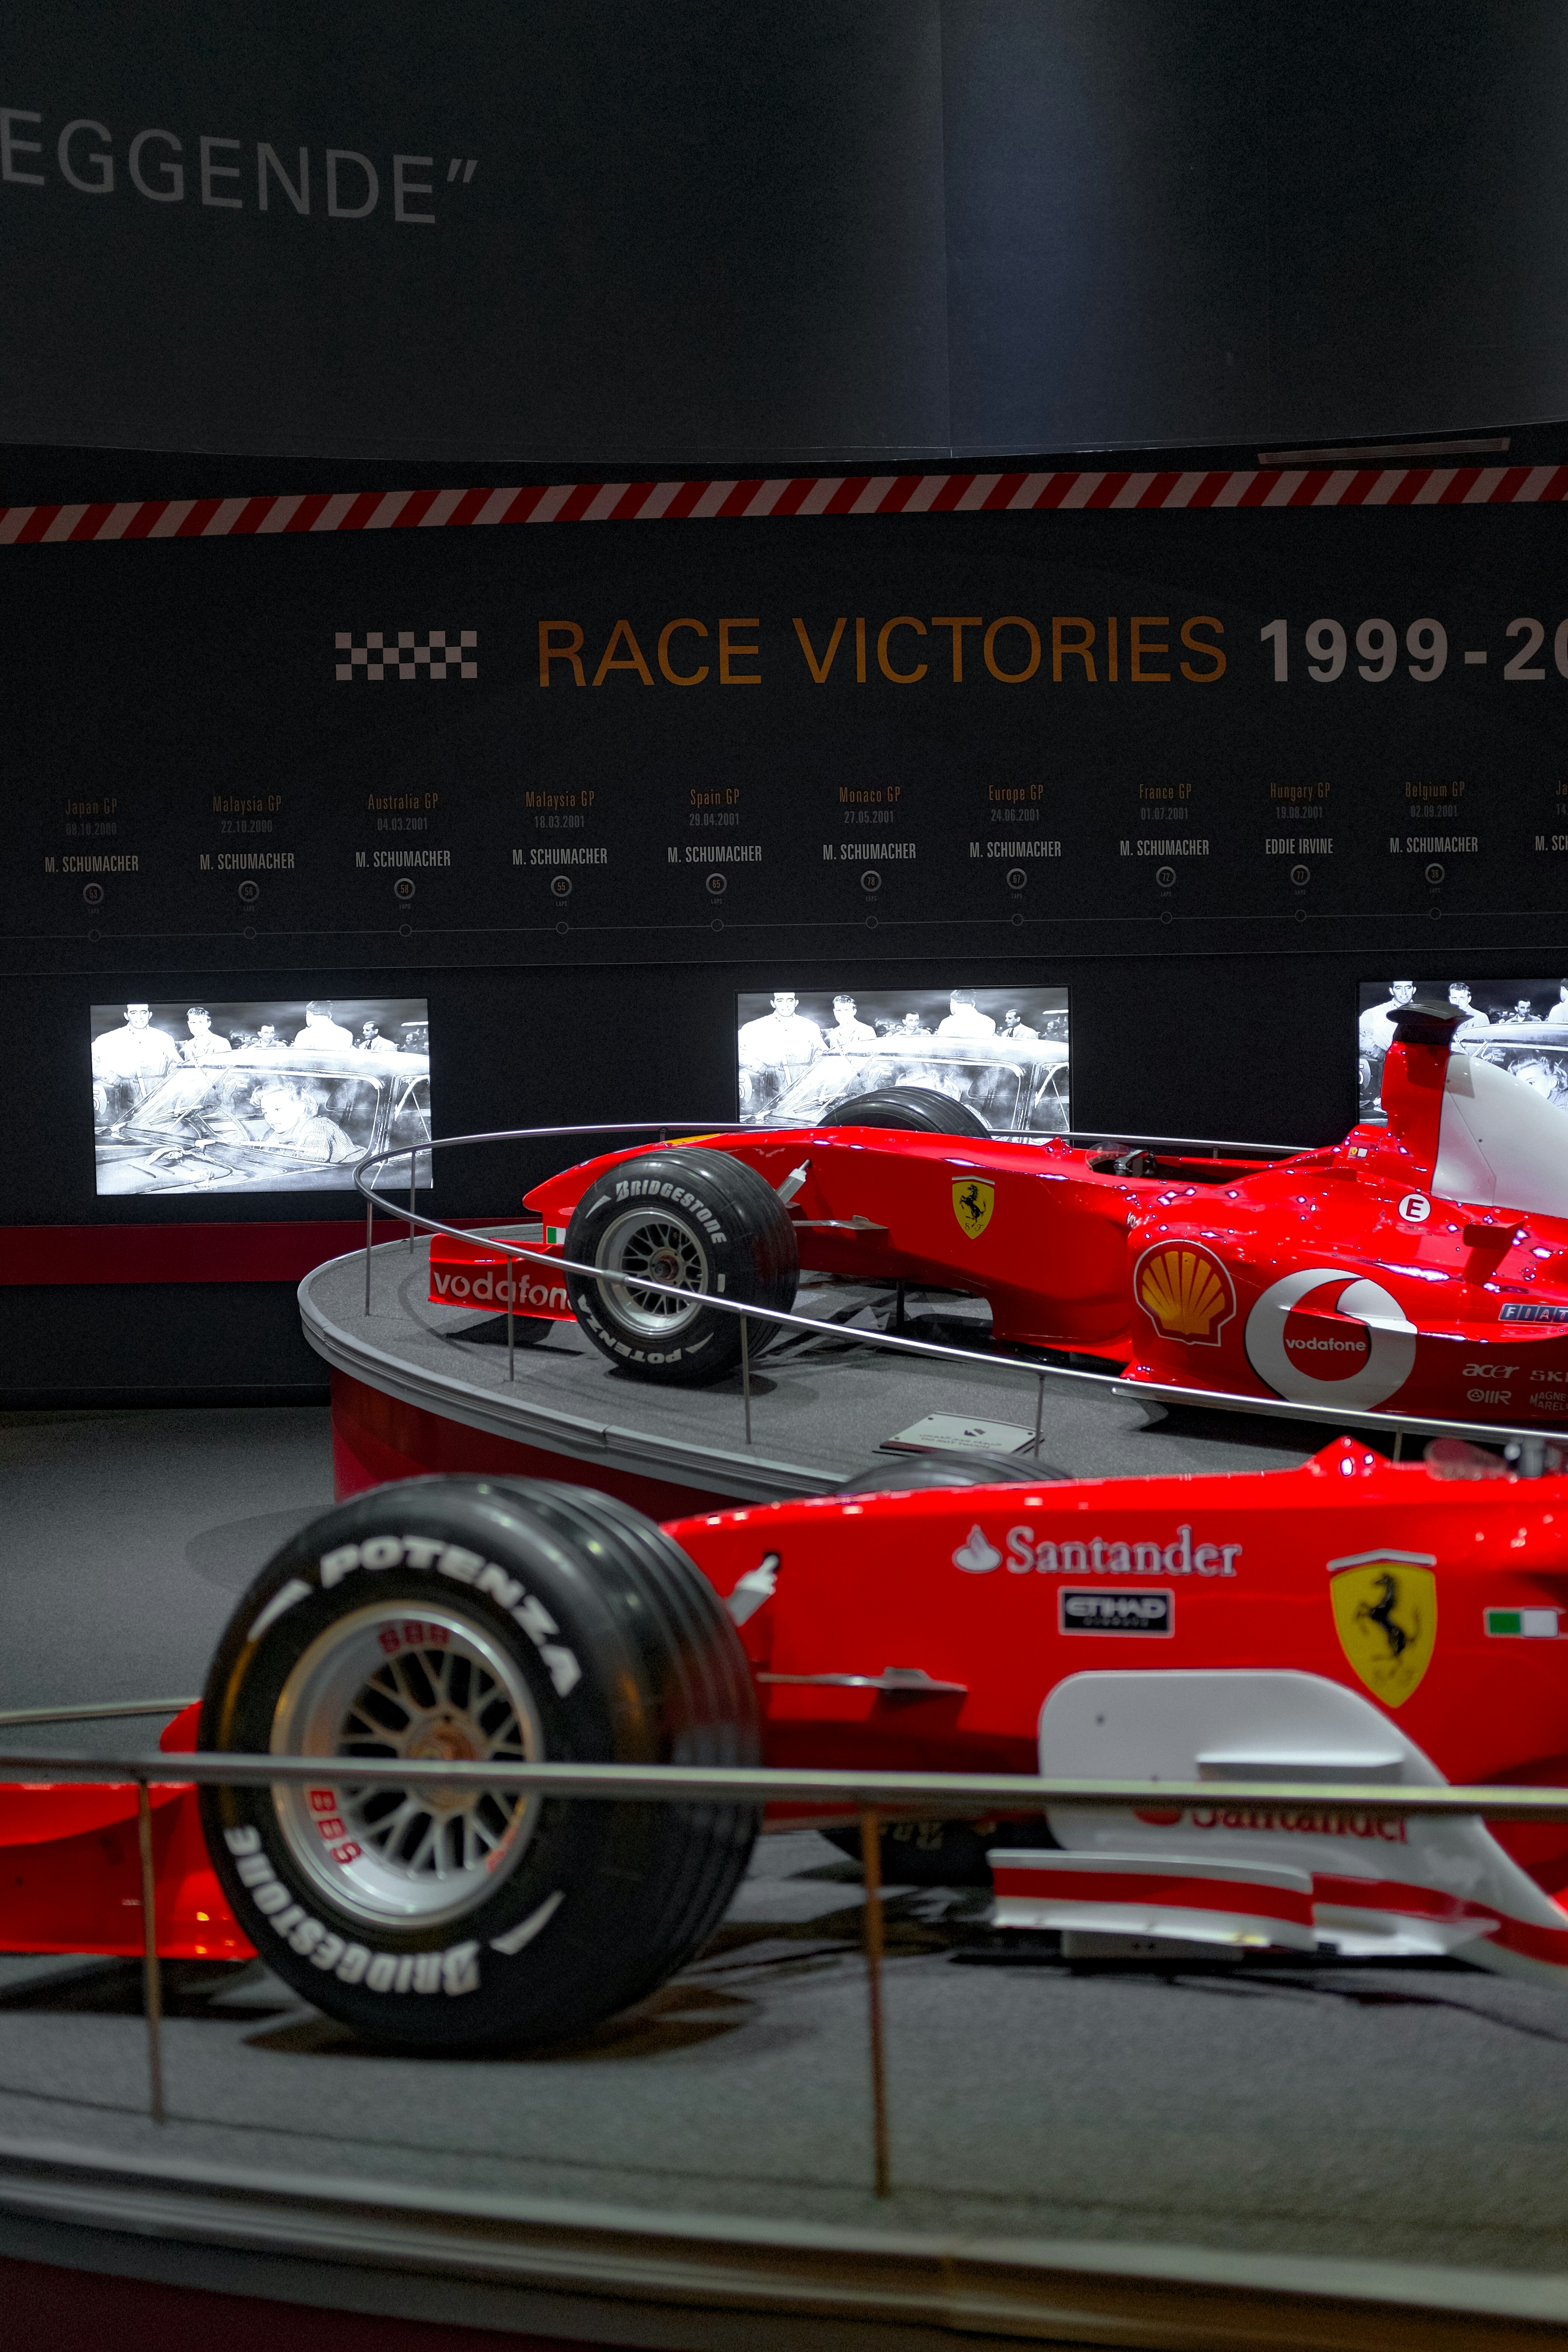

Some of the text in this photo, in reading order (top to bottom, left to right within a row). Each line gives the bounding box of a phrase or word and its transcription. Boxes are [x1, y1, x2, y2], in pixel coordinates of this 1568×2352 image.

[539, 618, 762, 687] RACE
[793, 616, 1227, 684] VICTORIES
[691, 788, 740, 808] Spain GP
[839, 786, 900, 802] Monaco GP
[989, 784, 1043, 804] Europe GP
[1139, 783, 1191, 799] France GP
[1271, 782, 1330, 802] Hungary GP
[1405, 781, 1465, 801] Belgium GP
[66, 798, 117, 818] Japan GP
[213, 795, 281, 815] Malaysia GP
[368, 793, 438, 810] Australia GP
[526, 790, 594, 810] Malaysia GP
[844, 810, 893, 823] 27.05.2001
[991, 808, 1039, 821] 24.06.2001
[1141, 807, 1188, 820] 01.07.2001
[1410, 805, 1457, 817] 02.09.2001
[221, 820, 273, 833] 22.10.2000
[377, 817, 427, 831] 04.03.2001
[535, 815, 584, 828] 18.03.2001
[689, 813, 739, 826] 29.04.2001
[823, 843, 916, 860] M. SCHUMACHER
[970, 841, 1061, 858] M. SCHUMACHER
[1120, 840, 1209, 856] M. SCHUMACHER
[1266, 838, 1333, 854] EDDIE IRVINE
[1390, 837, 1478, 853] M. SCHUMACHER
[1535, 836, 1548, 851] M.
[200, 853, 294, 870] M. SCHUMACHER
[356, 850, 450, 867] M. SCHUMACHER
[513, 848, 607, 865] M. SCHUMACHER
[668, 846, 762, 863] M. SCHUMACHER
[45, 855, 138, 872] M. SCHUMACHER
[867, 876, 876, 886] 78
[1012, 874, 1021, 884] 67
[1161, 873, 1171, 882] 72
[1296, 870, 1305, 880] 77
[1431, 868, 1439, 879] 36
[400, 884, 409, 894] 58
[557, 881, 566, 891] 55
[712, 879, 721, 889] 65
[616, 1180, 727, 1244] BRIDGESTONE
[1406, 1198, 1424, 1218] E
[434, 1271, 573, 1310] vodafon
[577, 1294, 682, 1364] POTENZA
[1285, 1337, 1366, 1351] vodafone
[1462, 1363, 1520, 1378] acer
[1530, 1370, 1568, 1383] SK
[1530, 1391, 1568, 1406] MAGNE
[1007, 1525, 1242, 1577] Santander
[320, 1535, 581, 1698] POTENZA
[225, 1825, 480, 1996] BRIDGESTONE
